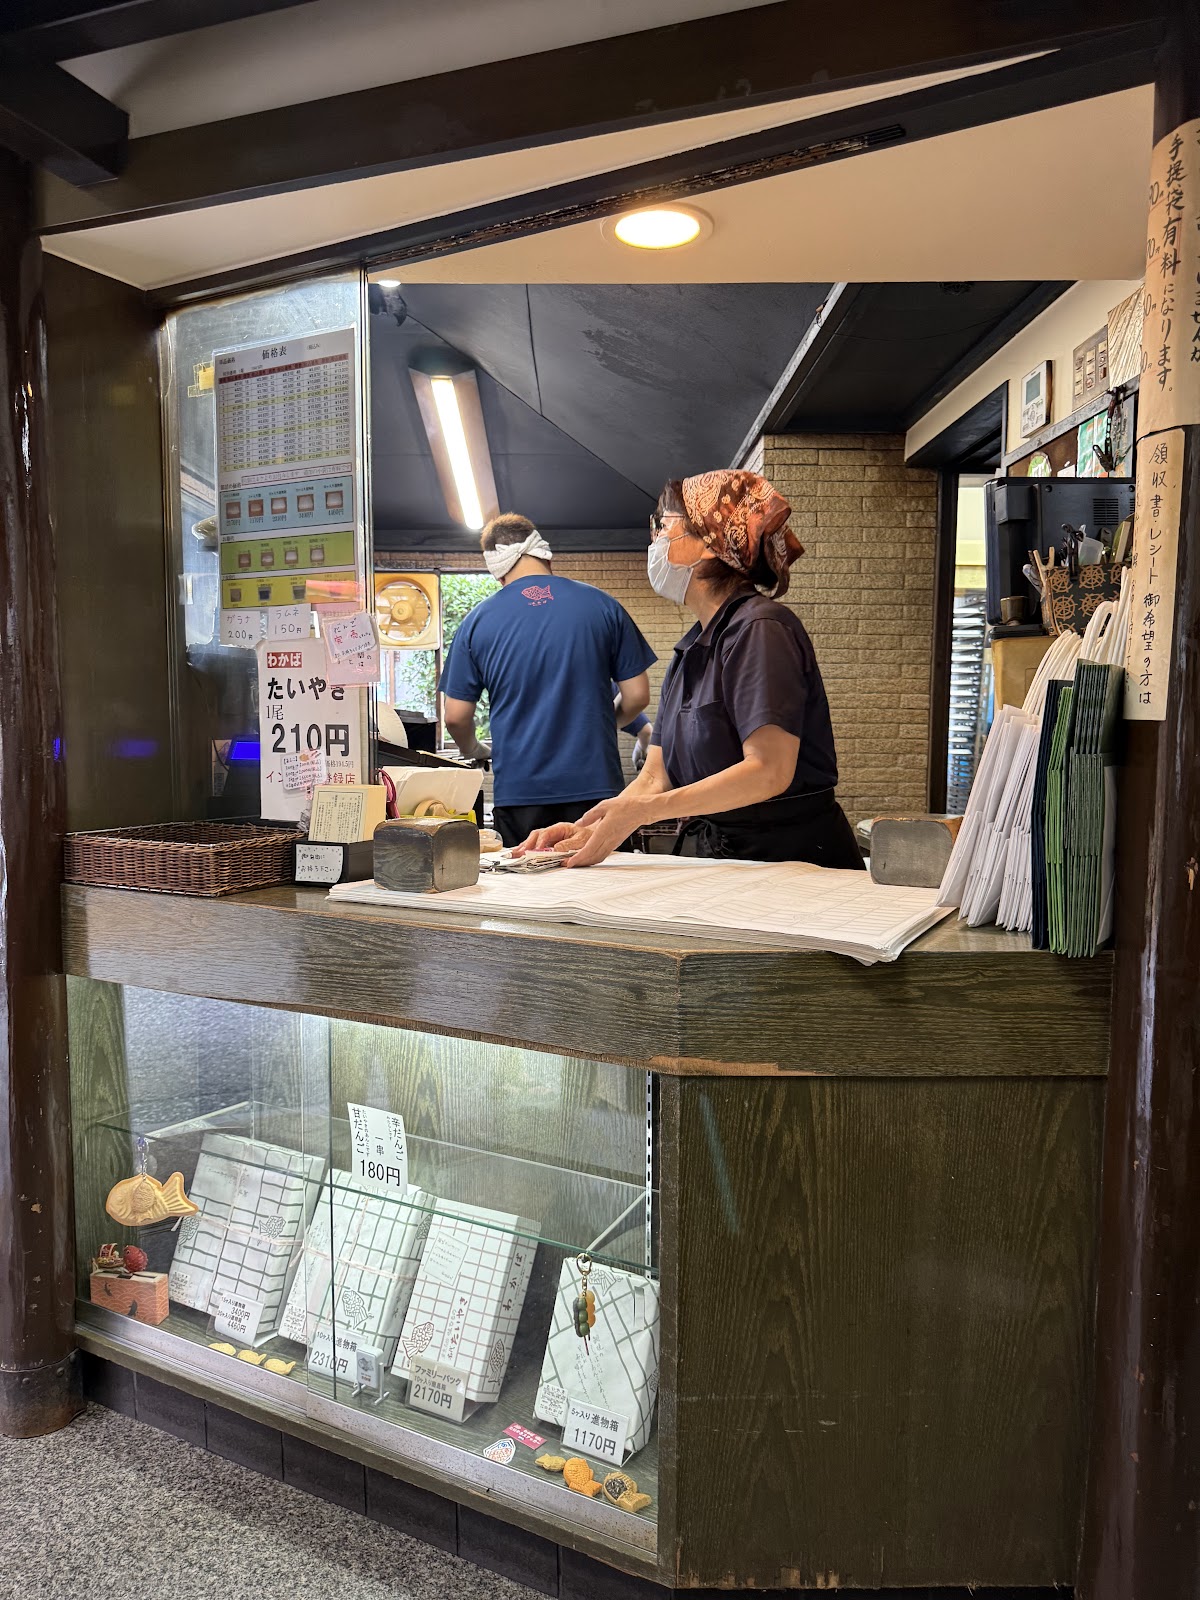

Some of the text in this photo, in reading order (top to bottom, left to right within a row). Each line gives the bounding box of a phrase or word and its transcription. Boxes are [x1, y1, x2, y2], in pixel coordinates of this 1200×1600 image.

[262, 346, 287, 360] 価格表
[226, 614, 251, 625] ガラナ
[275, 607, 300, 619] ラムネ
[227, 629, 253, 641] 200円
[274, 624, 302, 635] 150円
[267, 652, 303, 668] わかば
[267, 677, 345, 701] たいやき
[266, 705, 284, 720] 1尾
[271, 723, 350, 757] 210円
[351, 1107, 365, 1154] 甘だんご
[391, 1117, 404, 1162] 辛だんご
[360, 1159, 400, 1187] 180円
[230, 1307, 251, 1321] 3400円
[311, 1350, 349, 1374] 2310円
[415, 1364, 462, 1387] ファミリーパック
[413, 1383, 453, 1409] 2170円
[574, 1427, 617, 1456] 1170円
